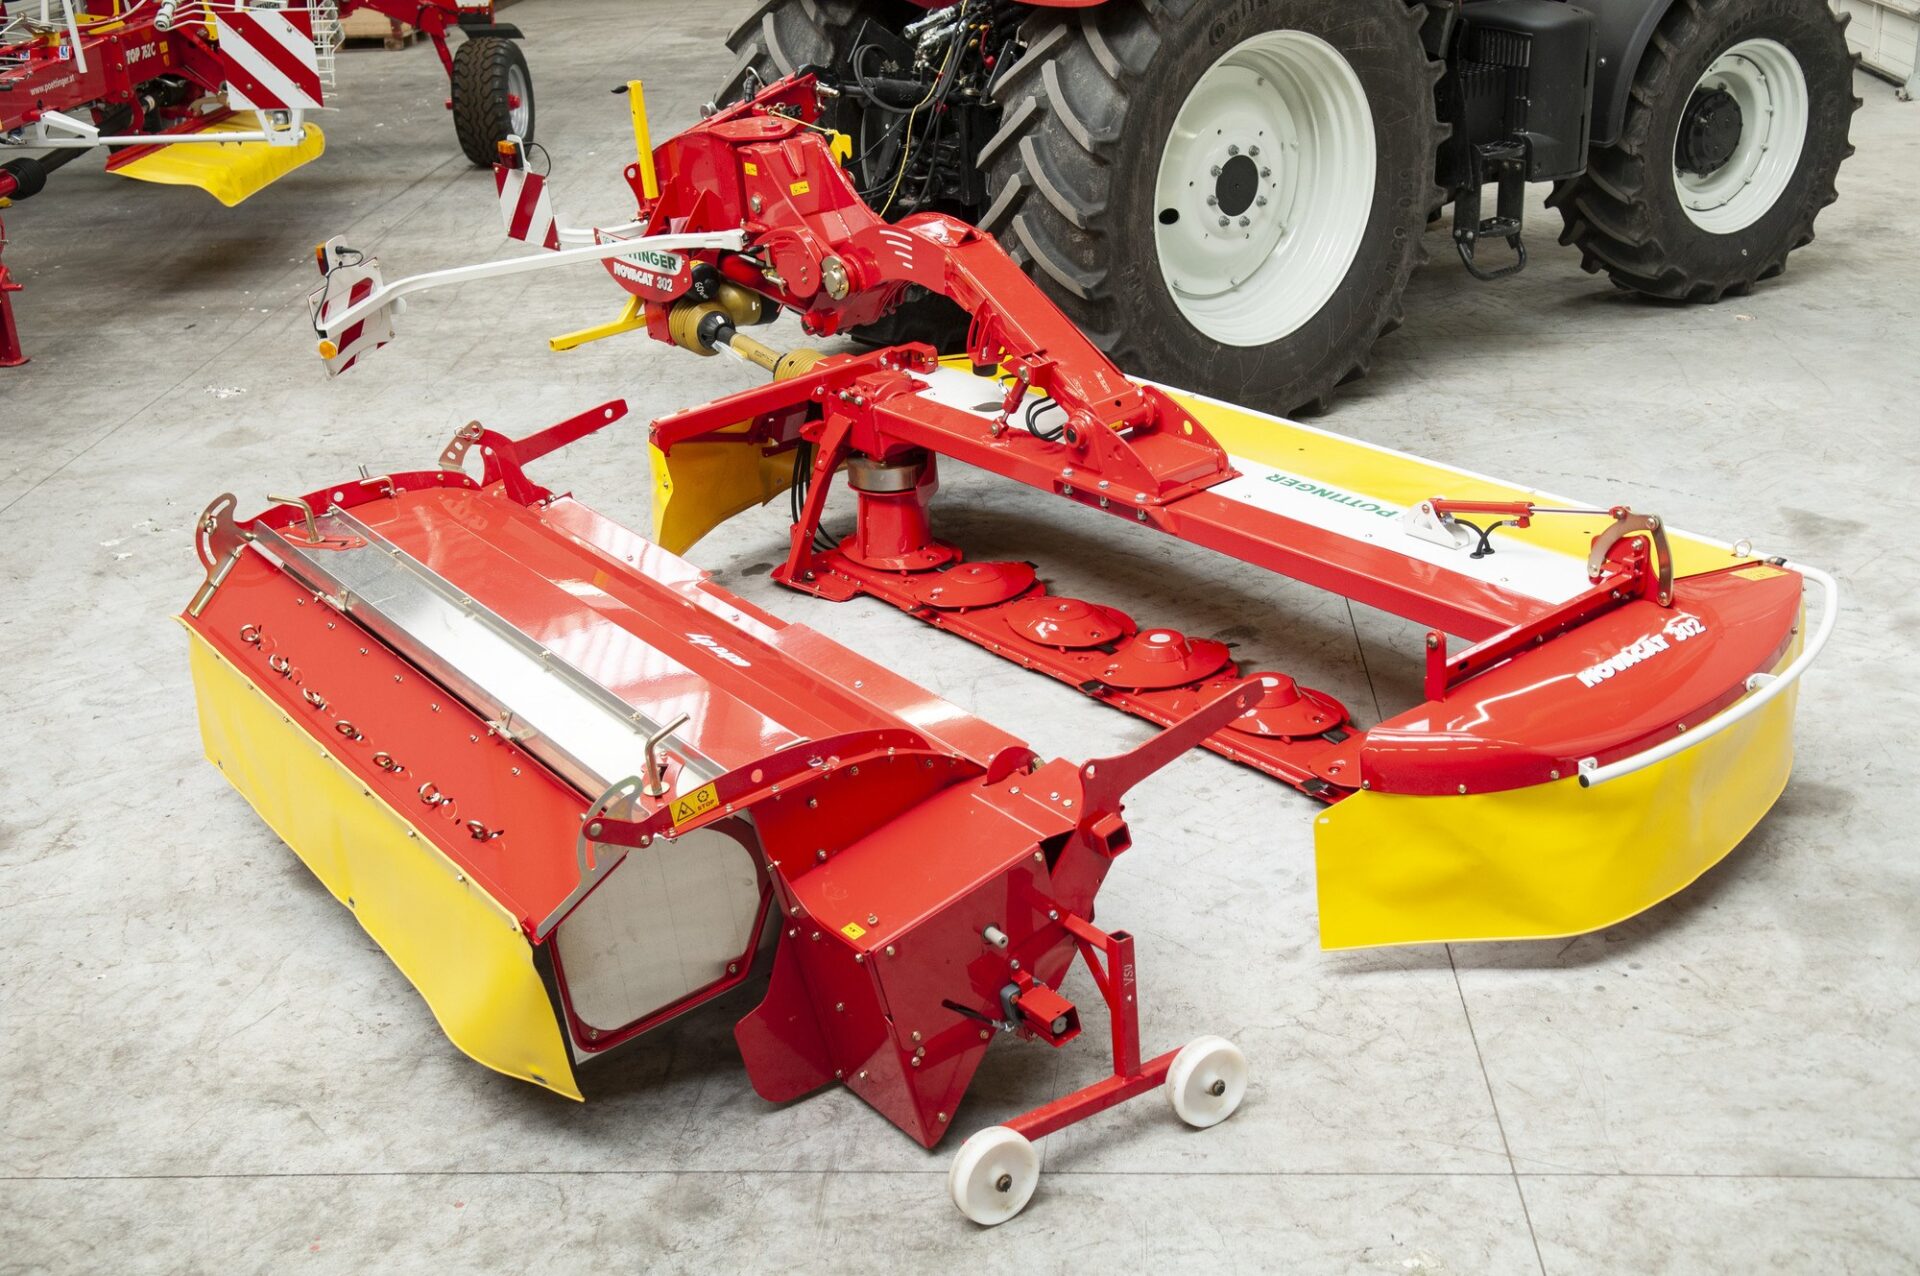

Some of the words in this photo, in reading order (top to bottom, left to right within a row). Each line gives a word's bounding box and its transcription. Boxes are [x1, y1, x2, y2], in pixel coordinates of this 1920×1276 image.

[125, 48, 141, 64] TOP
[30, 74, 75, 96] www.poettinger.at
[613, 261, 654, 286] NOVACAT
[656, 276, 673, 292] 302
[1575, 633, 1670, 688] NOVACAT
[1673, 617, 1706, 641] 302
[697, 799, 715, 811] STOP
